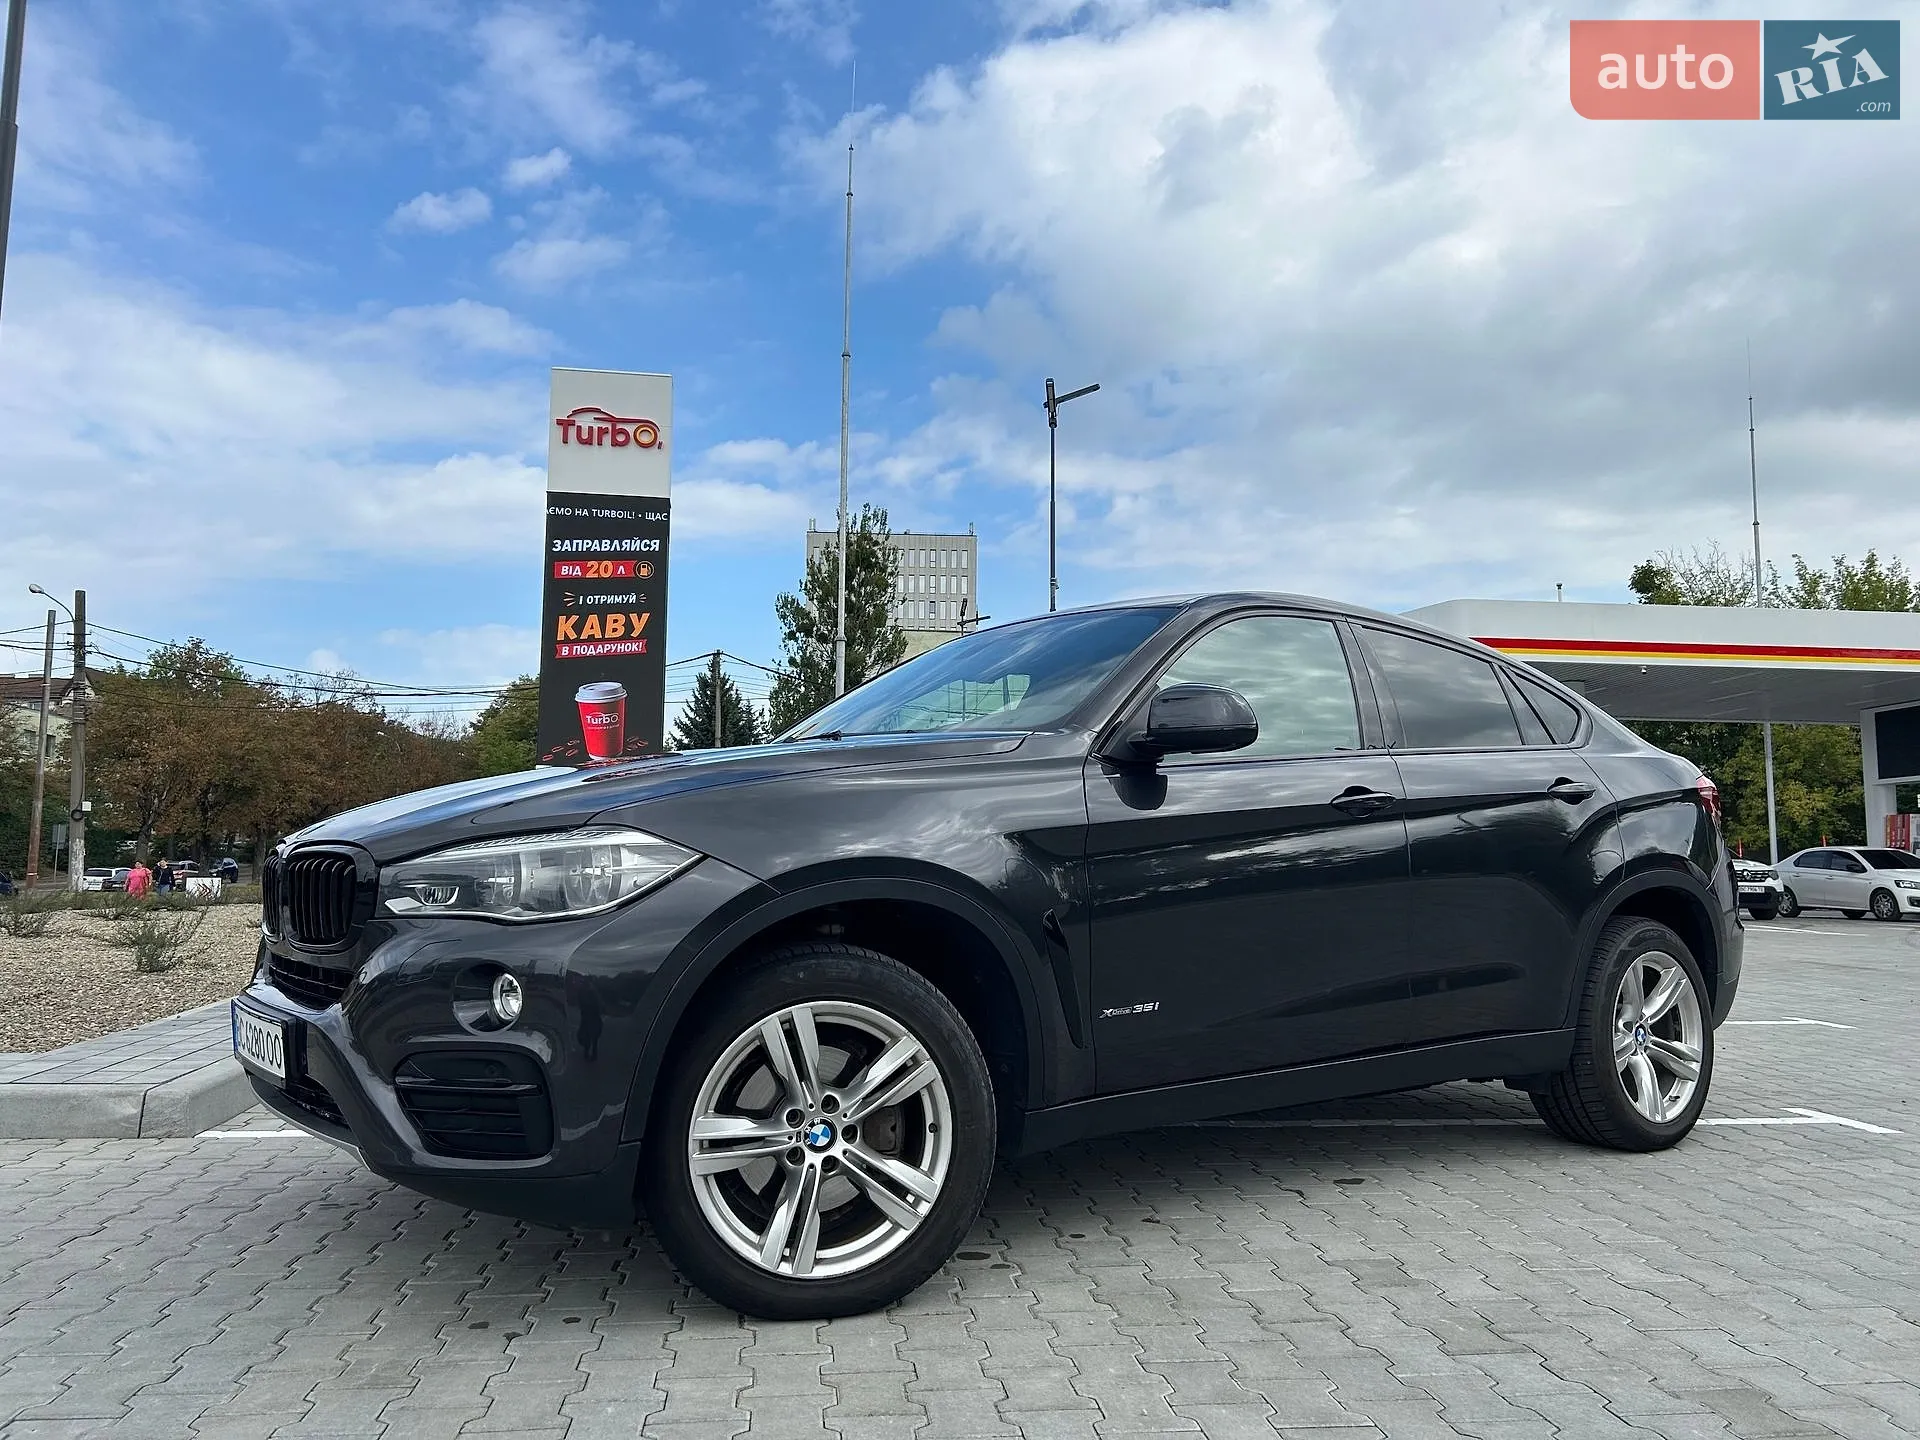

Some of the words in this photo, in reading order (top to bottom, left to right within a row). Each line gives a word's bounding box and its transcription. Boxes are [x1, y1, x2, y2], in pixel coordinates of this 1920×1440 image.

[574, 508, 589, 517] НА
[552, 536, 660, 552] ЗАПРАВЛЯЙСЯ
[560, 565, 582, 577] ВІД
[585, 560, 614, 579] 20
[586, 592, 637, 605] ОТРИМУЙ
[556, 612, 651, 641] КАВУ
[561, 645, 569, 656] В
[572, 641, 643, 656] ПОДАРУНОК!
